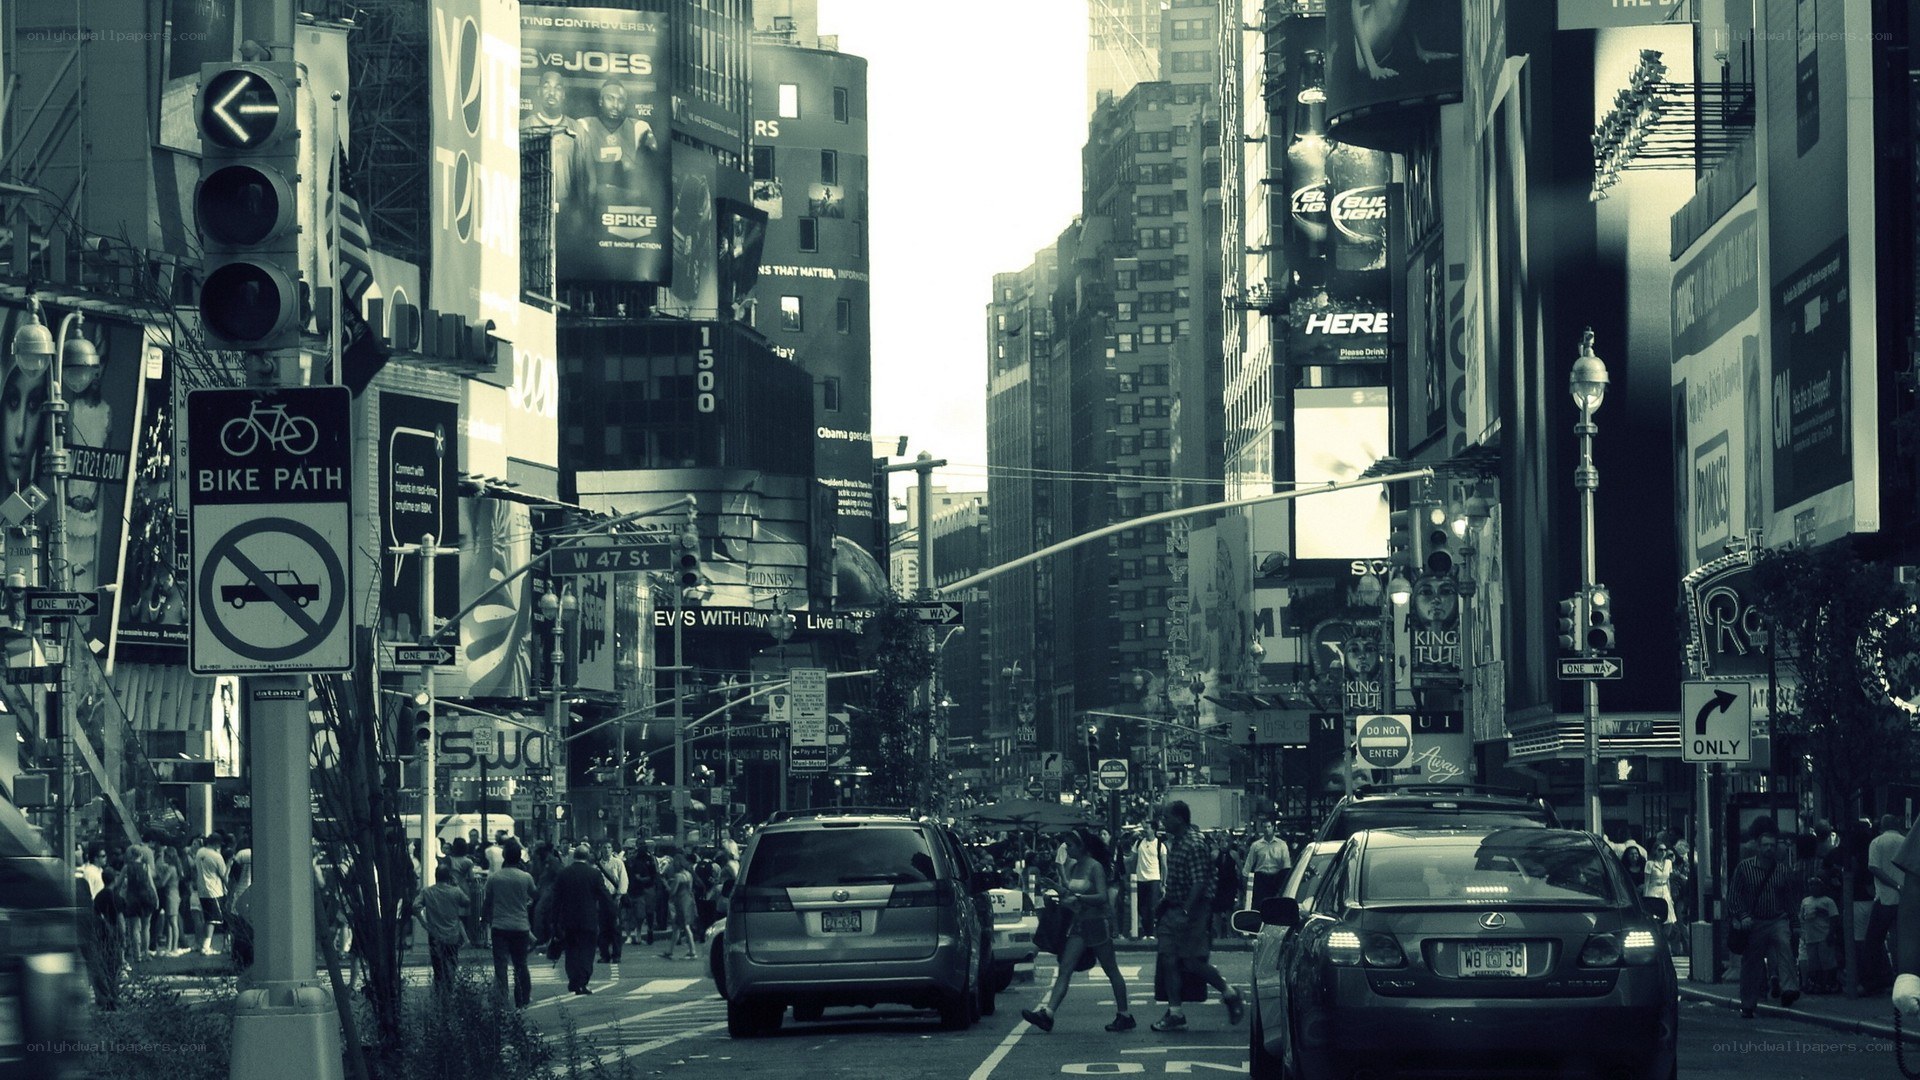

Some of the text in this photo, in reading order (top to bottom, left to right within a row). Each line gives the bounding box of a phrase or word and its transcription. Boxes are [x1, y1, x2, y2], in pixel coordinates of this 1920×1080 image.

[553, 17, 657, 33] CONTROVERSY.
[564, 50, 653, 76] JOES
[601, 213, 658, 228] SPIKE
[1338, 208, 1387, 221] LIGH
[773, 265, 799, 276] THAT
[1340, 347, 1385, 357] Please Drink
[697, 326, 715, 414] 1500
[817, 426, 848, 440] Obama
[199, 466, 342, 492] BIKE PATH
[573, 549, 650, 569] W 47 St
[36, 599, 88, 610] ONE WAY
[700, 610, 741, 627] WITH
[929, 608, 953, 619] WAY
[807, 614, 834, 630] Live
[1414, 630, 1458, 647] KING
[403, 650, 447, 661] ONE WAY
[1414, 645, 1459, 666] TUT
[1566, 663, 1613, 674] ONE WAY
[1346, 680, 1380, 693] KING
[1346, 692, 1379, 711] TUT
[1366, 725, 1401, 736] DO NOT
[1612, 720, 1621, 733] W
[1626, 720, 1641, 733] 47
[1369, 749, 1399, 758] ENTER
[1693, 739, 1741, 756] ONLY
[1413, 745, 1465, 784] Away
